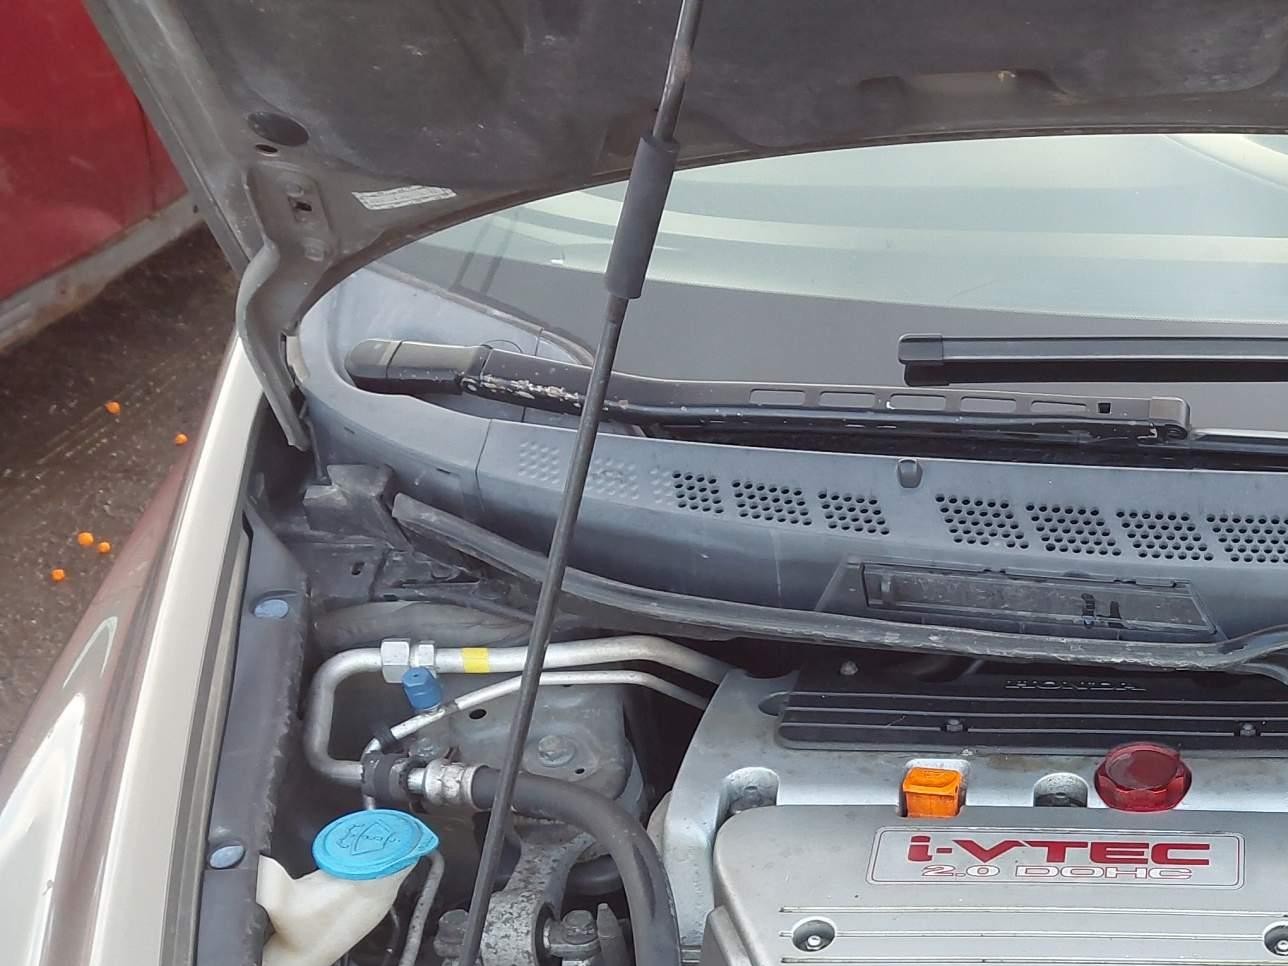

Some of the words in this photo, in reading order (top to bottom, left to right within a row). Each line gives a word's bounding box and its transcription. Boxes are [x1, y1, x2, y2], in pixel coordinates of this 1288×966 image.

[906, 834, 1211, 866] i-VTEC
[921, 864, 1000, 877] 2.0
[1015, 866, 1193, 880] DOHC
